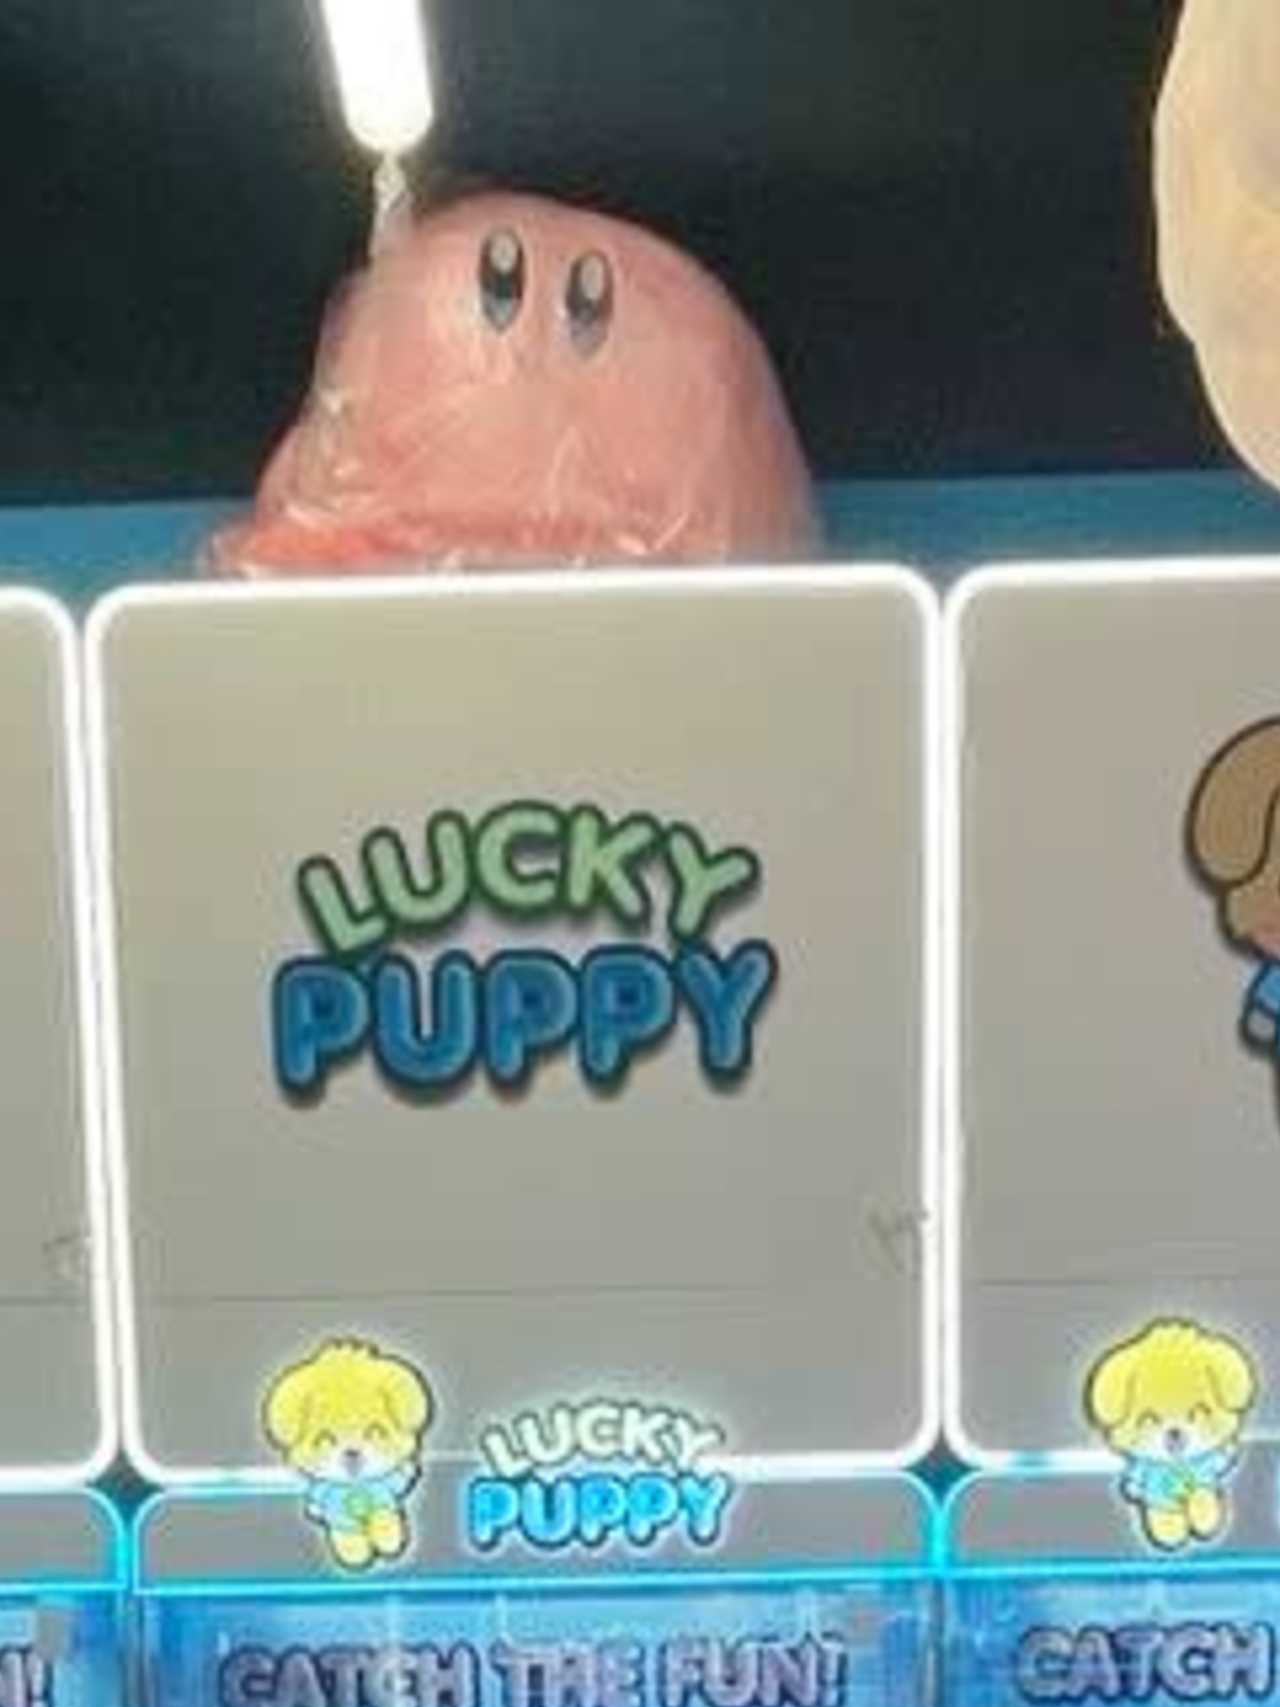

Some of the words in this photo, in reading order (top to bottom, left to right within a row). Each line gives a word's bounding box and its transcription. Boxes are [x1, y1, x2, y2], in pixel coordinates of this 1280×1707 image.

[298, 800, 761, 960] LUCKY
[273, 939, 778, 1108] PUPPY
[479, 1400, 723, 1478] LUCKY
[465, 1474, 729, 1550] PUPPY
[1020, 1622, 1277, 1703] CATCH
